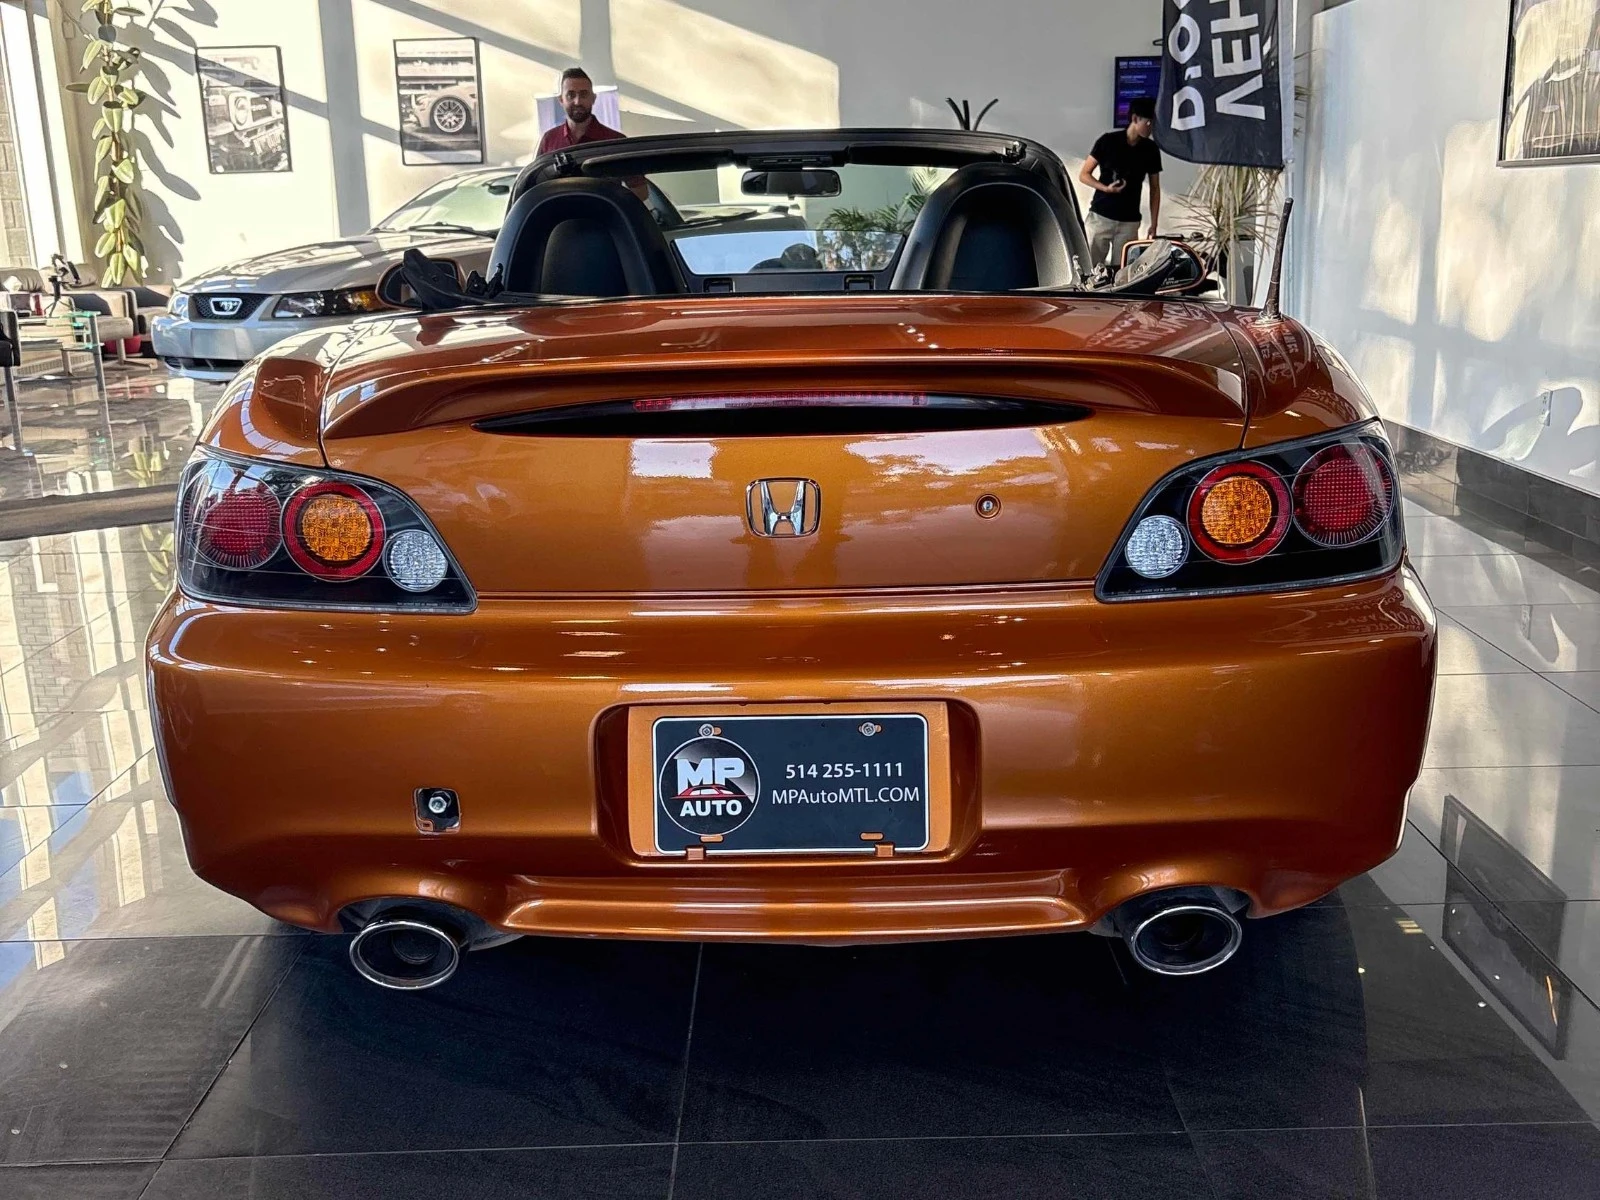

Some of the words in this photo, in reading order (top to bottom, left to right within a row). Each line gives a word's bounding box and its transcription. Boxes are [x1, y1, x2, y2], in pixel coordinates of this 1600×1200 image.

[676, 757, 745, 796] MP
[785, 763, 819, 779] 514
[822, 762, 903, 778] 255-1111
[771, 786, 920, 805] MPAutoMTL.COM
[679, 799, 743, 817] AUTO
